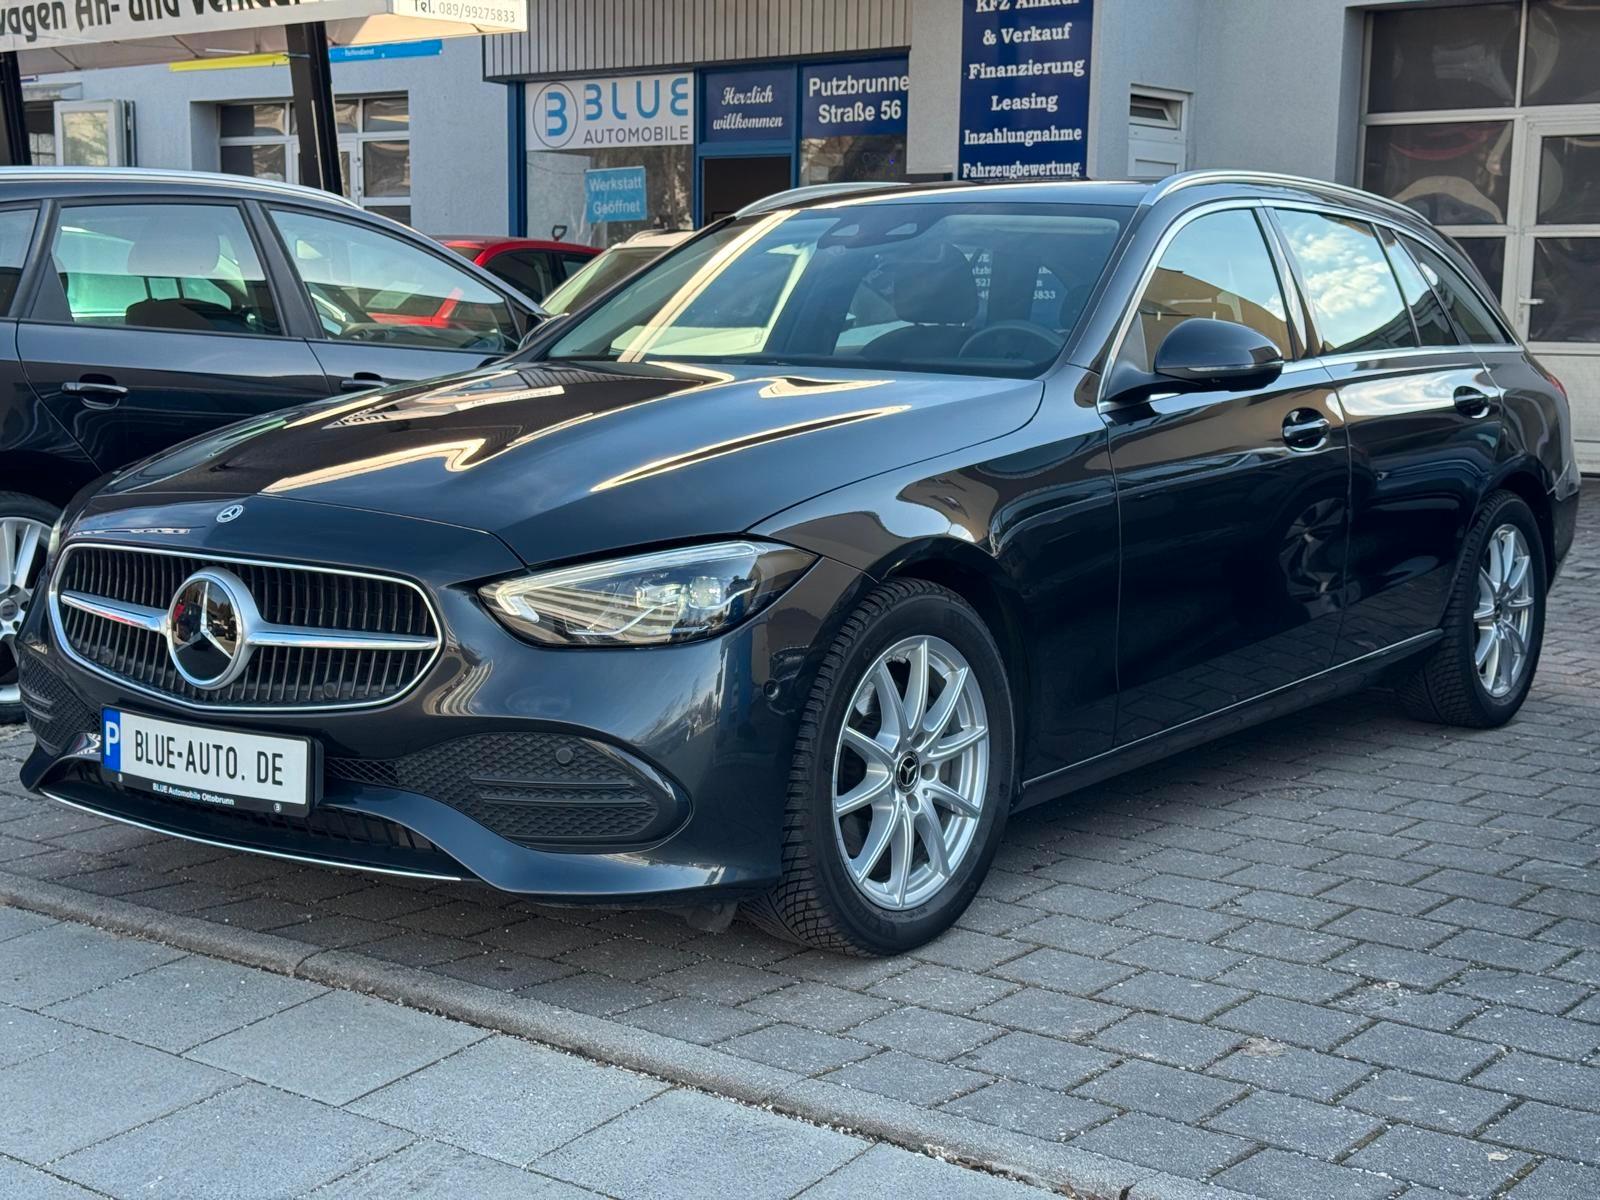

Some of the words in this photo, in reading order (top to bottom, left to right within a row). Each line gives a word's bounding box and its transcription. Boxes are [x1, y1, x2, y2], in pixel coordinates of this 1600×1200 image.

[414, 0, 436, 15] Tel.
[438, 2, 516, 23] 089/99275833
[982, 29, 997, 46] &
[1001, 22, 1073, 44] Verkauf
[968, 59, 1086, 80] Finanzierung
[583, 77, 689, 121] BLUE
[721, 84, 774, 106] Herzlich
[990, 92, 1059, 112] Leasing
[713, 112, 783, 130] willkommen
[818, 102, 875, 124] Straße
[880, 100, 902, 120] 56
[583, 125, 689, 144] AUTOMOBILE
[964, 125, 1082, 147] Inzahlungnahme
[962, 160, 1080, 179] Fahrzeugbewertung
[588, 176, 642, 192] Werkstatt
[592, 201, 641, 215] Geöffnet
[105, 720, 120, 756] P
[152, 782, 168, 794] BLUE
[168, 785, 201, 801] Automobile
[201, 792, 235, 806] Ottobrunn
